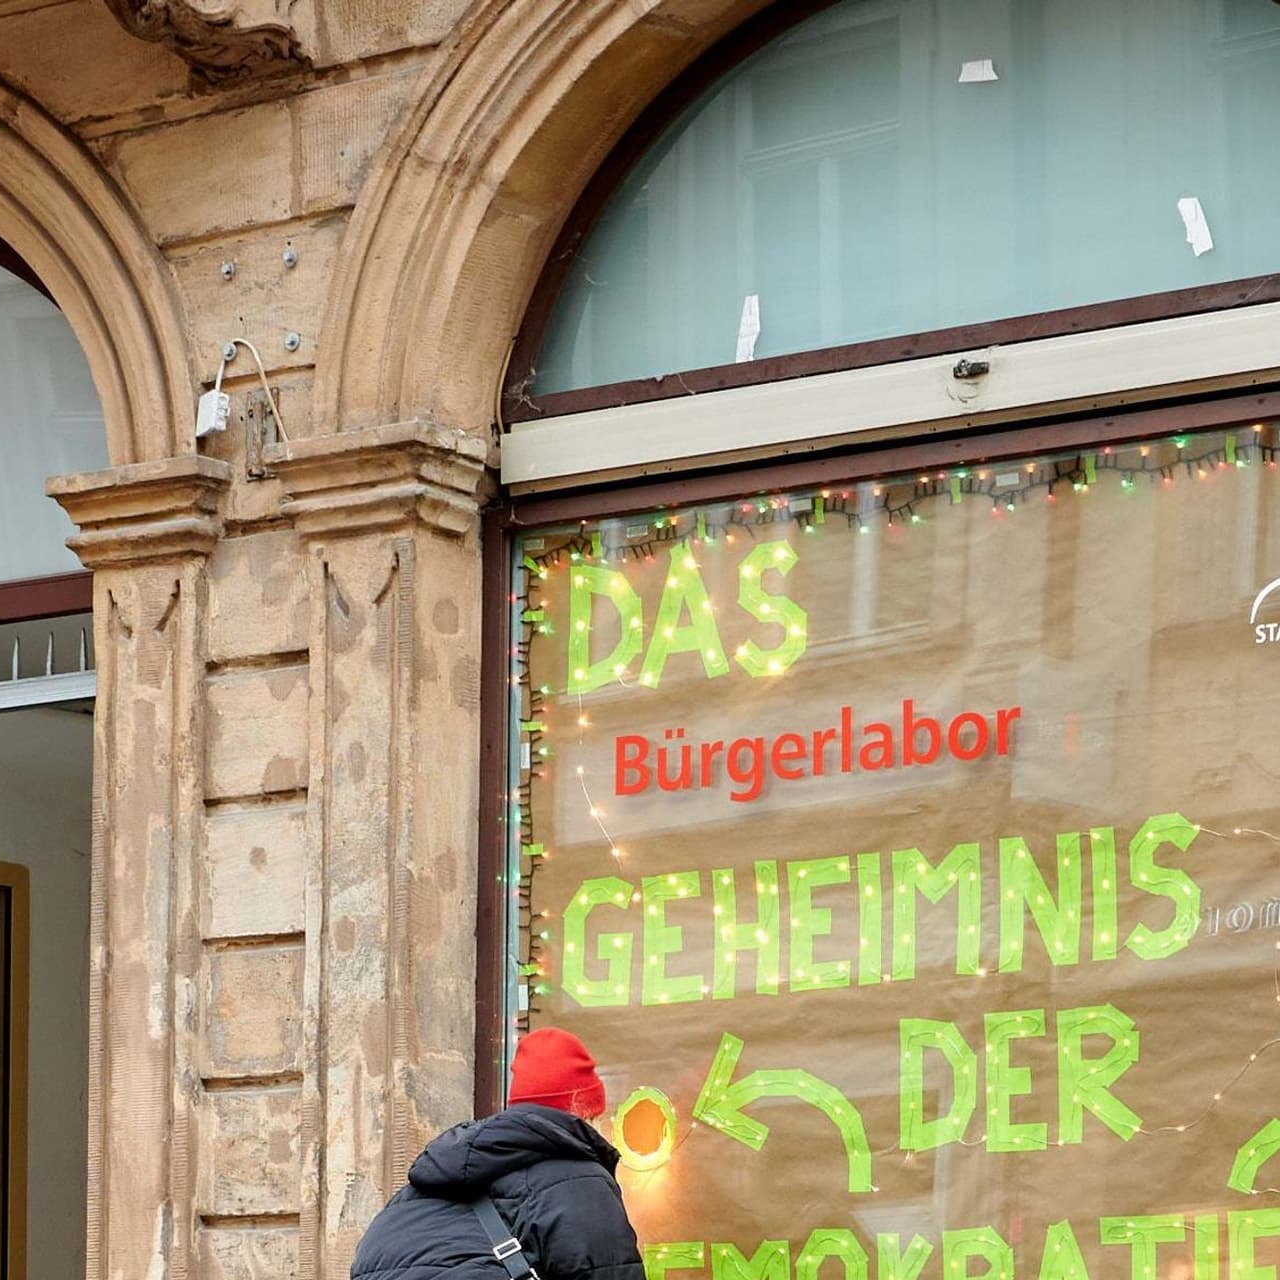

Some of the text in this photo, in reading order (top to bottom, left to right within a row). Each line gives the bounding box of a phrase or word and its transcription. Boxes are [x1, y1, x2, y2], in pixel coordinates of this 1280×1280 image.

[567, 540, 808, 695] DAS
[614, 698, 1021, 803] Bürgerlabor
[561, 812, 1203, 1008] GEHEIMNIS
[899, 1003, 1143, 1153] DER
